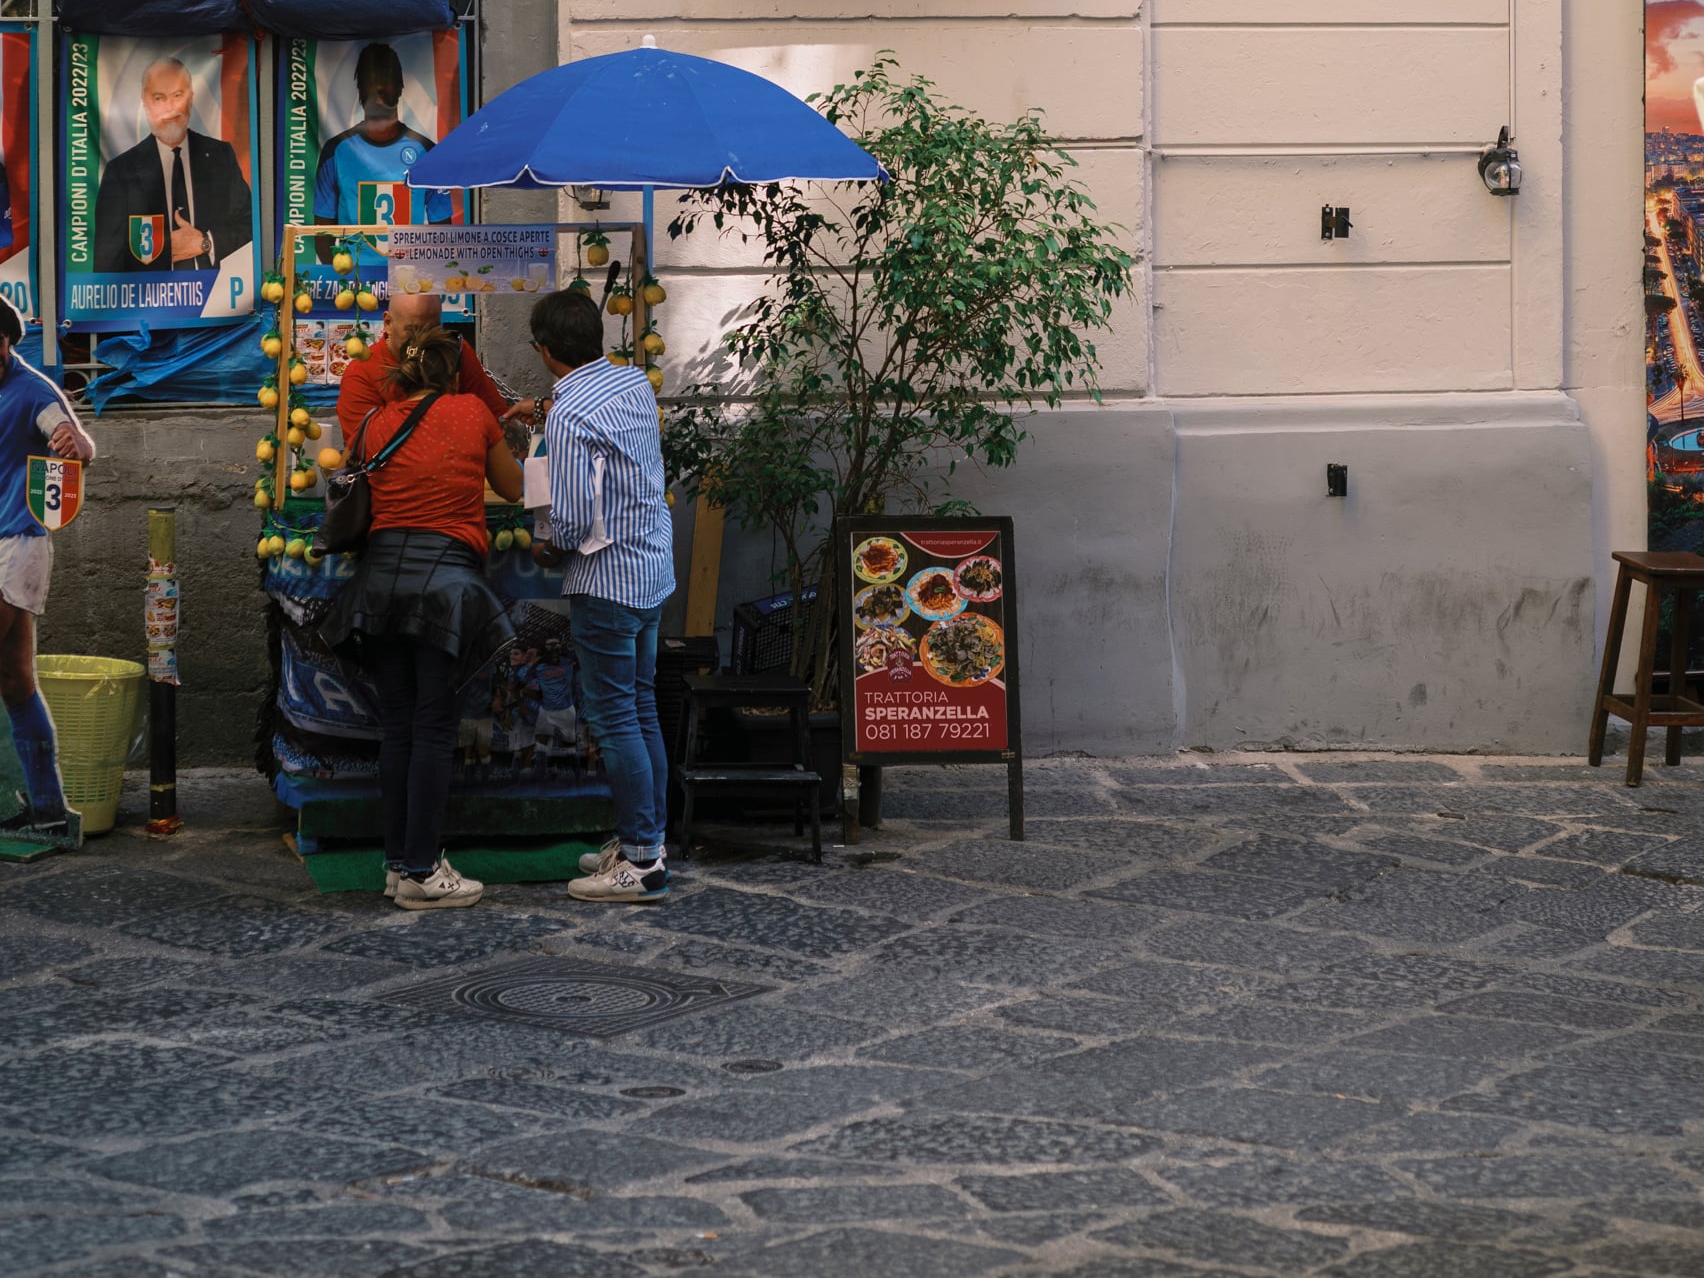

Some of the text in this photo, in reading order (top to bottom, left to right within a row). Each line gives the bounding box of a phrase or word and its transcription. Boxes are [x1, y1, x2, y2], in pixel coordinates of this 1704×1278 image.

[291, 38, 307, 101] 2022/23
[289, 105, 307, 170] D'ITALIA
[71, 42, 89, 263] CAMPIONI D'ITALIA 2022/23
[139, 223, 153, 256] 3
[393, 231, 550, 245] SPREMUTE DI LIMONE A COSCE APERTE
[409, 246, 535, 260] LEMONADE WITH OPEN THIGHS
[71, 281, 203, 310] AURELIO DE LAURENTIIS
[229, 276, 244, 310] P
[31, 463, 78, 475] NAPOLI
[45, 483, 61, 511] 3
[864, 691, 949, 704] TRATTORIA
[864, 706, 990, 721] SPERANZELLA
[865, 722, 990, 740] 081 187 79221
